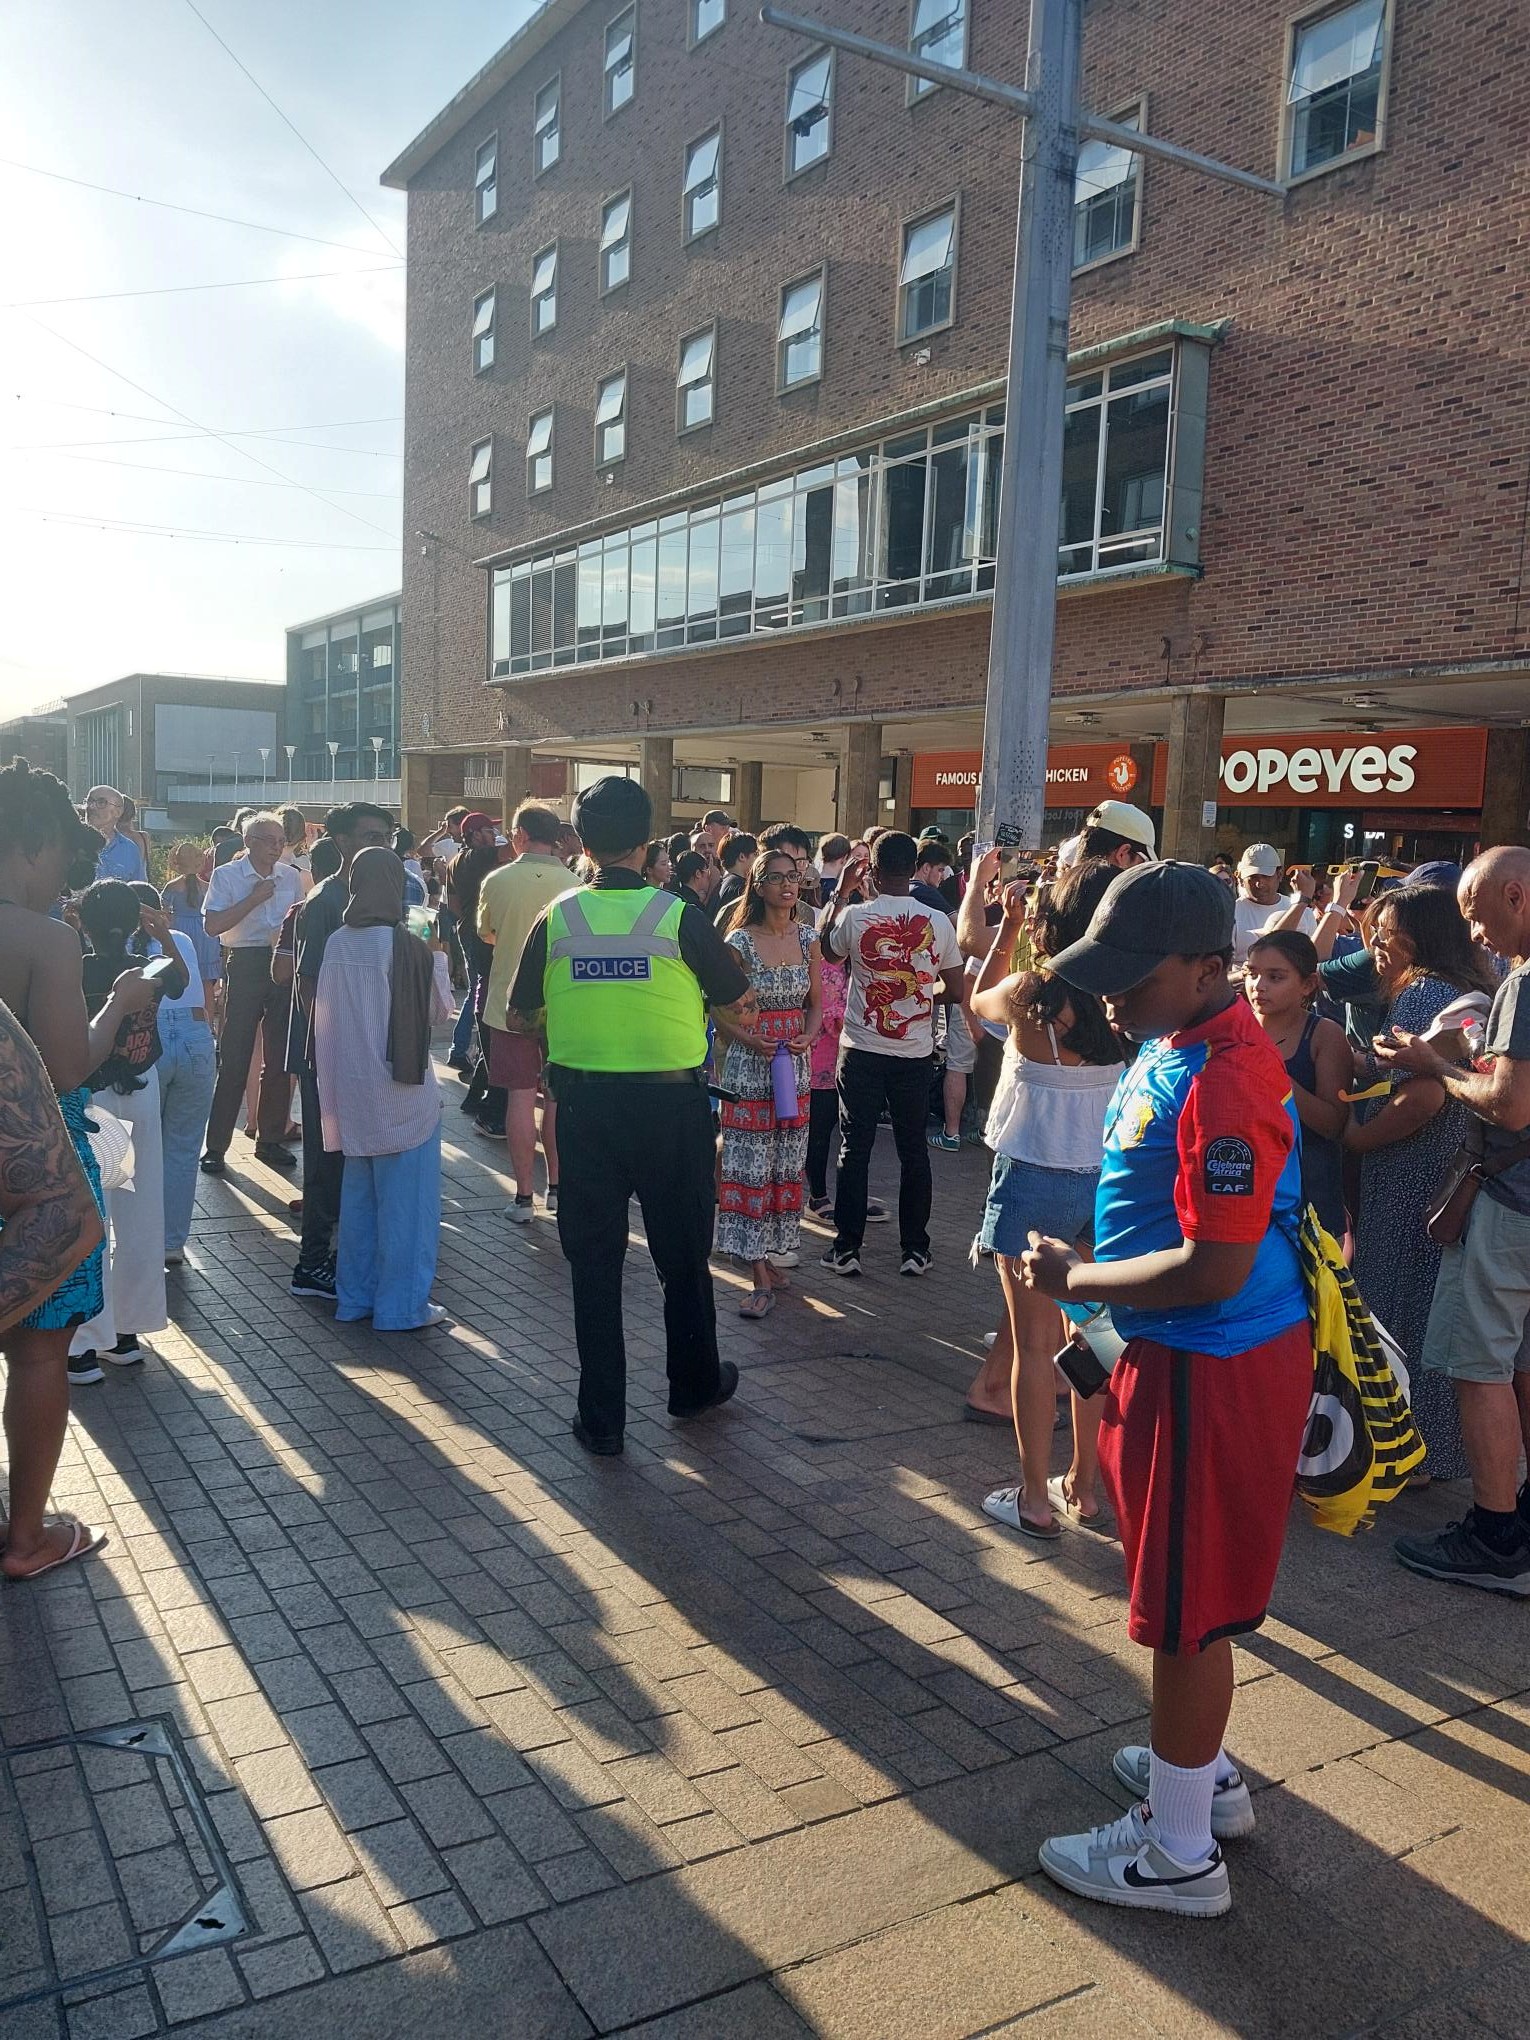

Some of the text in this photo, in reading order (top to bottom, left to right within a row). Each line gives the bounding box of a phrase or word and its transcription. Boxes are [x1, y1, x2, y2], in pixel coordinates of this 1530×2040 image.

[936, 772, 977, 785] FAMOUS
[1045, 768, 1088, 783] HICKEN
[574, 960, 647, 976] POLICE
[1207, 1160, 1250, 1171] Celebrate
[1214, 1168, 1242, 1176] Africa
[1212, 1183, 1244, 1192] CAF
